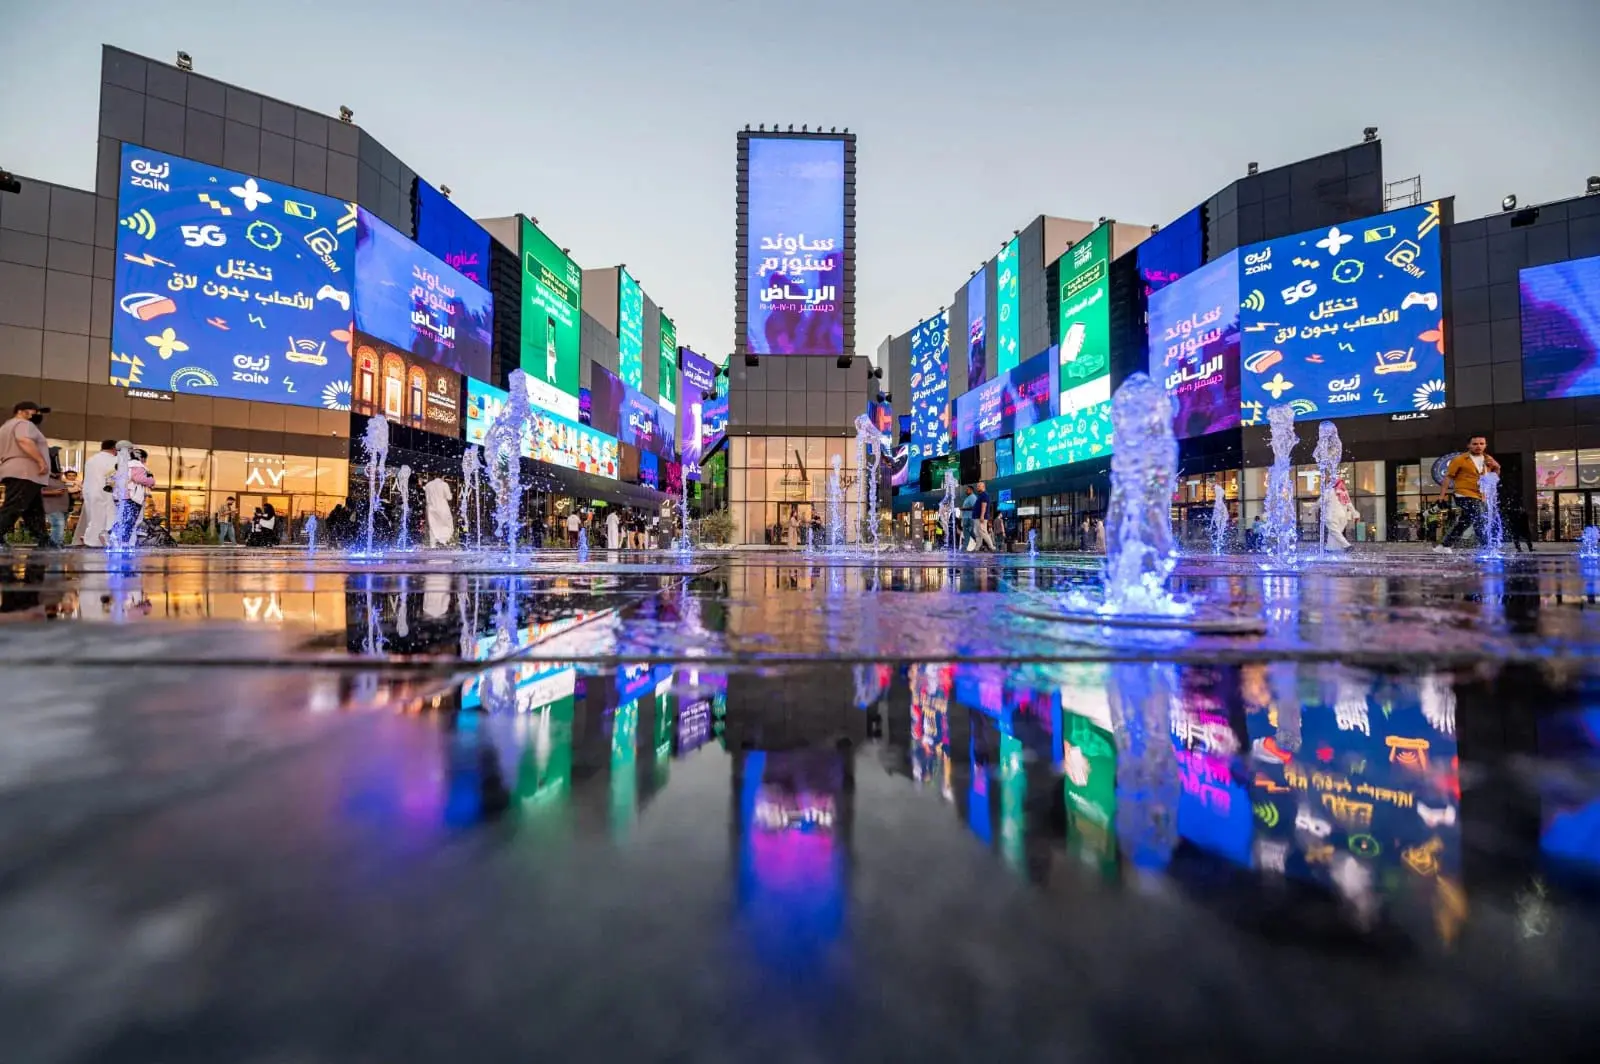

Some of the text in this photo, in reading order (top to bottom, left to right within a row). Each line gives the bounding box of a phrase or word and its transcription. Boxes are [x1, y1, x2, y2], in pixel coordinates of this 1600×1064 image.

[131, 160, 169, 178] زين
[181, 225, 227, 247] 5G
[760, 233, 834, 255] ساوند
[757, 254, 835, 277] ستورم
[1244, 247, 1271, 265] زين
[168, 272, 197, 291] لاق
[203, 280, 249, 302] بدون
[412, 264, 455, 298] ساوند
[409, 284, 455, 315] ستورم
[760, 284, 835, 304] الرياض
[1281, 280, 1318, 305] 5G
[798, 303, 834, 313] ديسمبر
[411, 310, 455, 340] الرياض
[1165, 305, 1221, 341] ساوند
[1300, 321, 1339, 339] بدون
[1274, 326, 1297, 344] لاق
[1163, 327, 1221, 367] ستورم
[233, 354, 270, 372] زين
[1165, 354, 1223, 390] الرياض
[1328, 374, 1360, 392] زين
